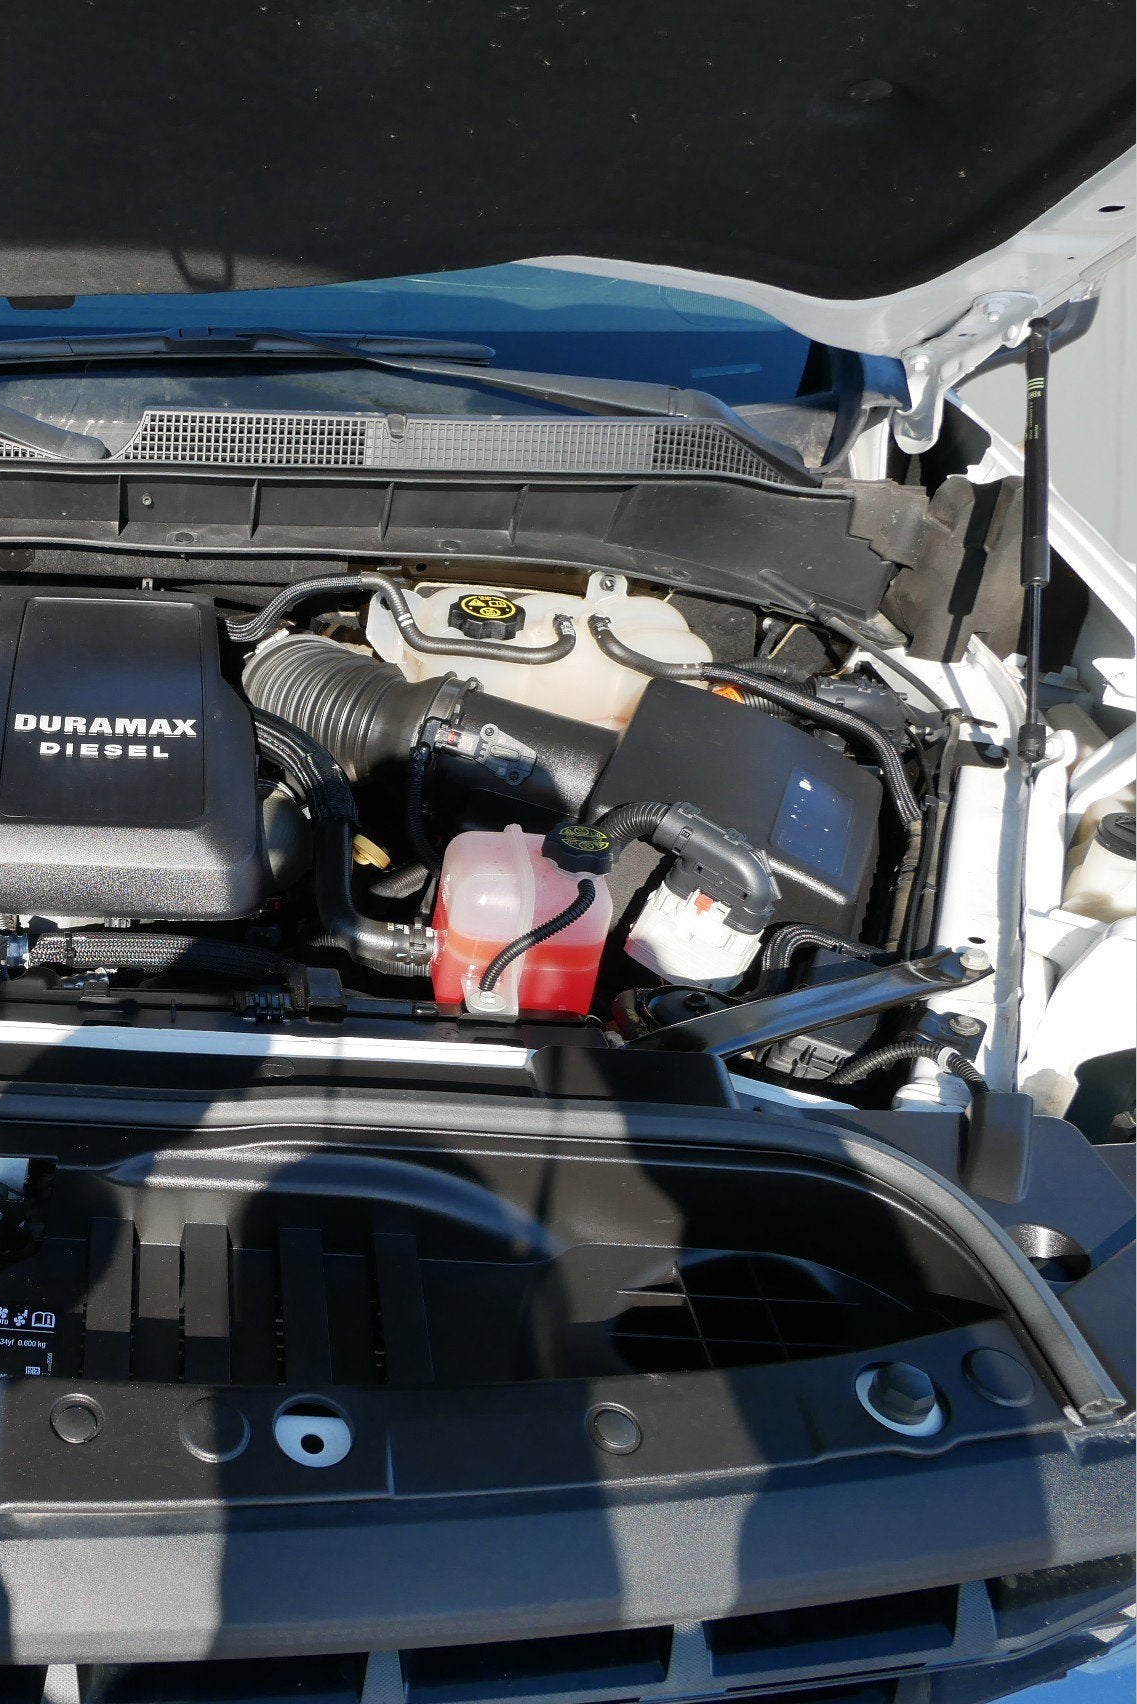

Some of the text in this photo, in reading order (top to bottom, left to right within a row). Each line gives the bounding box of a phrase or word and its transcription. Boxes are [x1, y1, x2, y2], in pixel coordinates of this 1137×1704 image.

[14, 713, 197, 738] DURAMAX
[39, 741, 169, 759] DIESEL
[37, 1341, 46, 1349] kg
